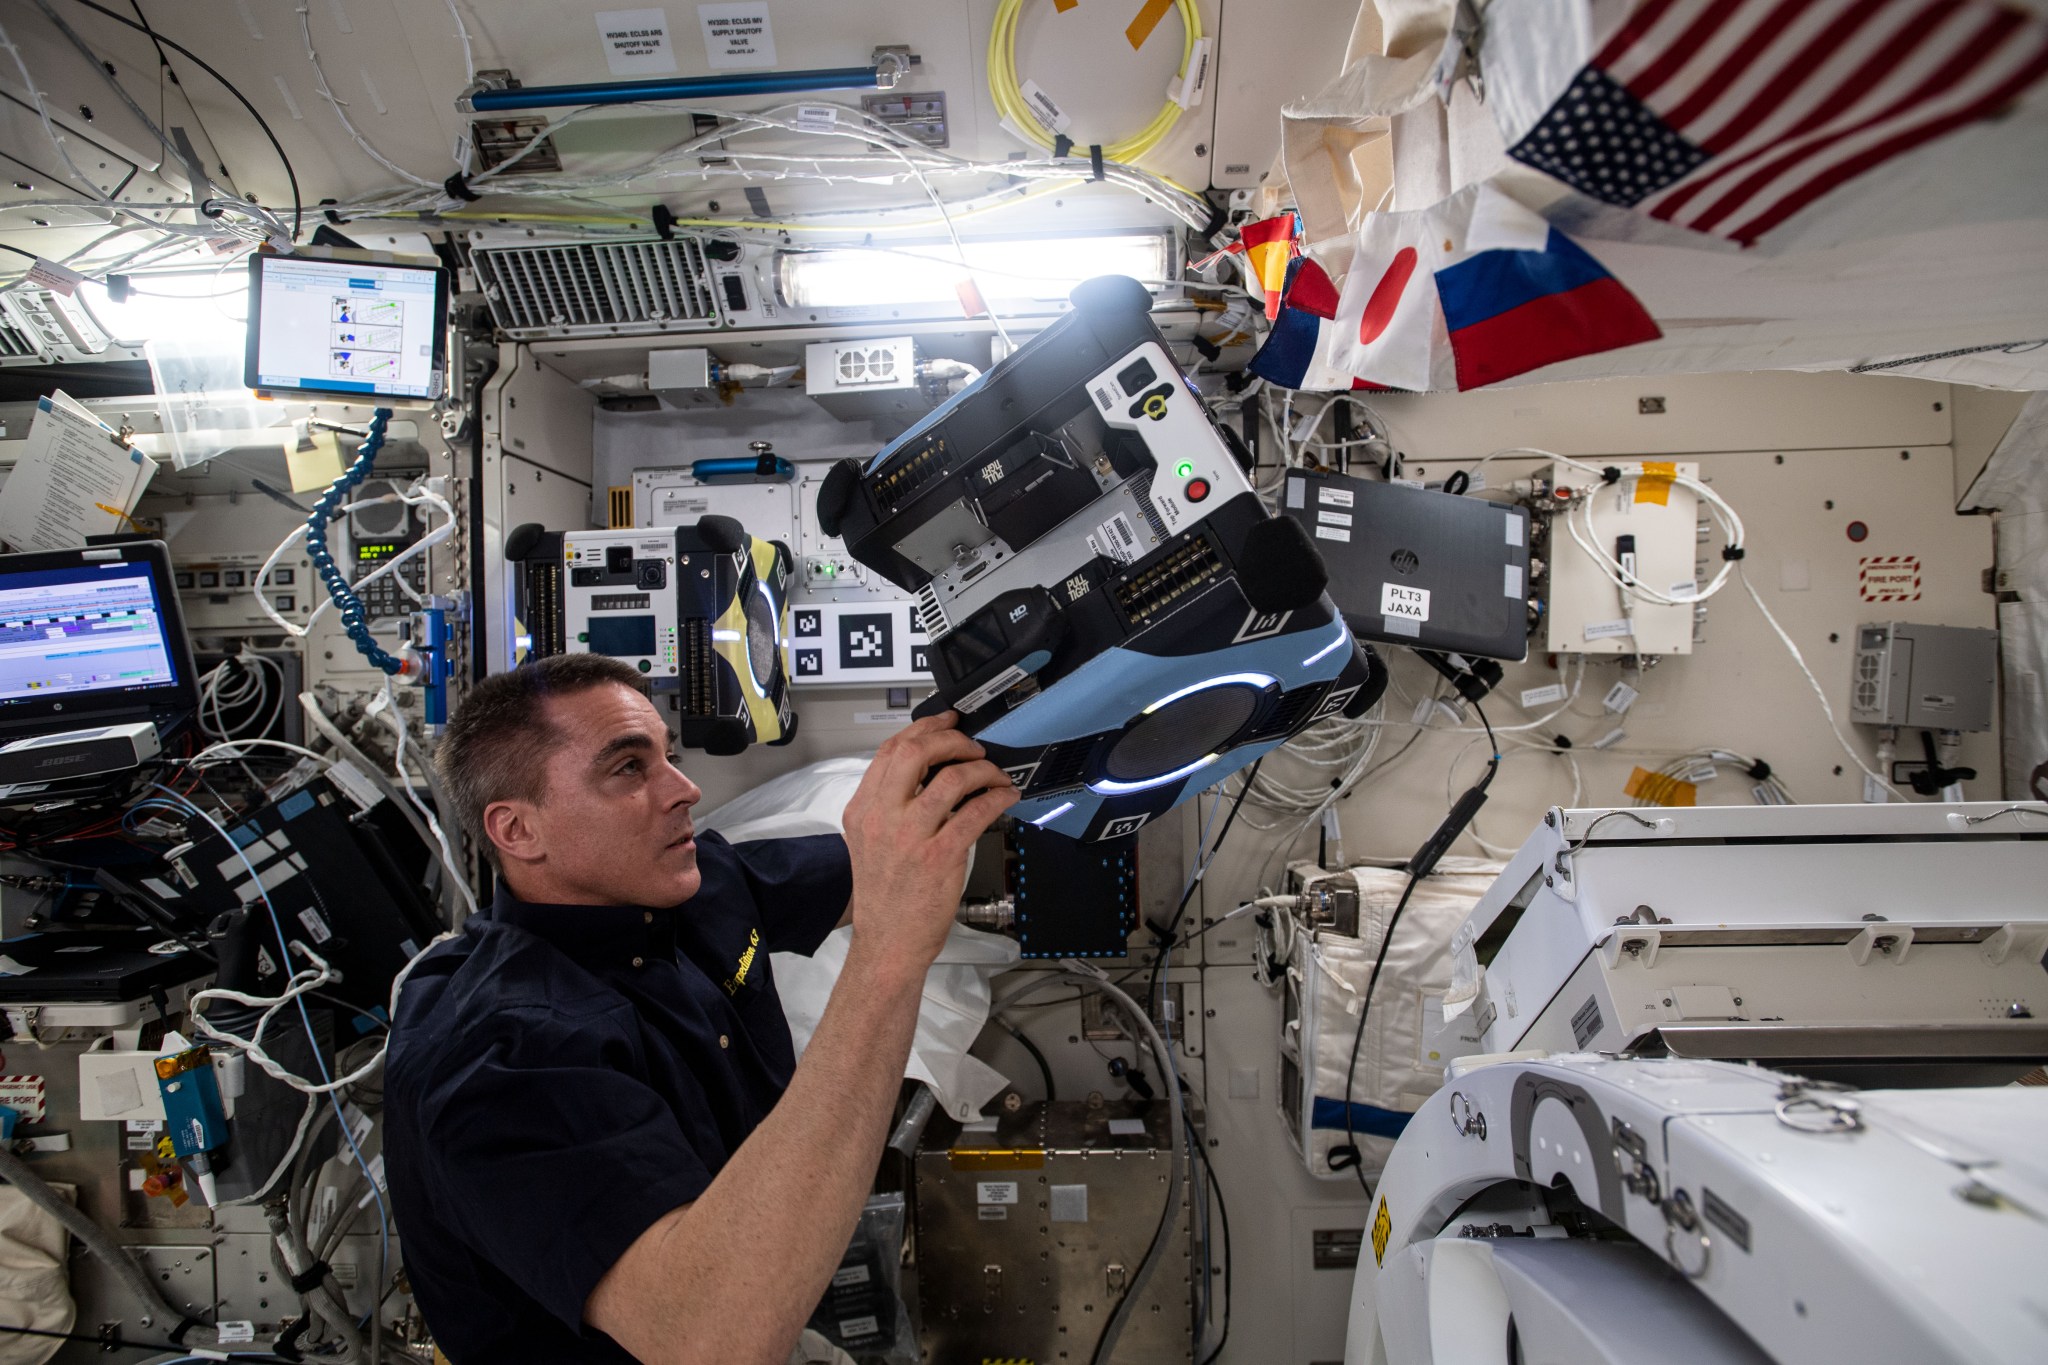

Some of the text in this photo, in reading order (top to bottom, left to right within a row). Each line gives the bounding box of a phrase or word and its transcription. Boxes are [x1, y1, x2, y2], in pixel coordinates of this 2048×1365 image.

[711, 28, 734, 36] SUPPLY
[432, 372, 441, 396] CHRIS
[982, 459, 1002, 479] TIGHT
[984, 468, 1005, 485] PULL
[1158, 495, 1172, 516] Forward
[1168, 498, 1180, 515] Module
[1066, 574, 1087, 592] PULL
[1889, 575, 1912, 583] PORT
[1067, 580, 1090, 602] TIGHT
[1391, 587, 1422, 602] PLT3
[1009, 604, 1027, 620] HD
[1388, 602, 1422, 616] JAXA
[38, 753, 90, 768] BOSE
[724, 946, 756, 996] Expedition
[13, 1096, 36, 1104] PORT
